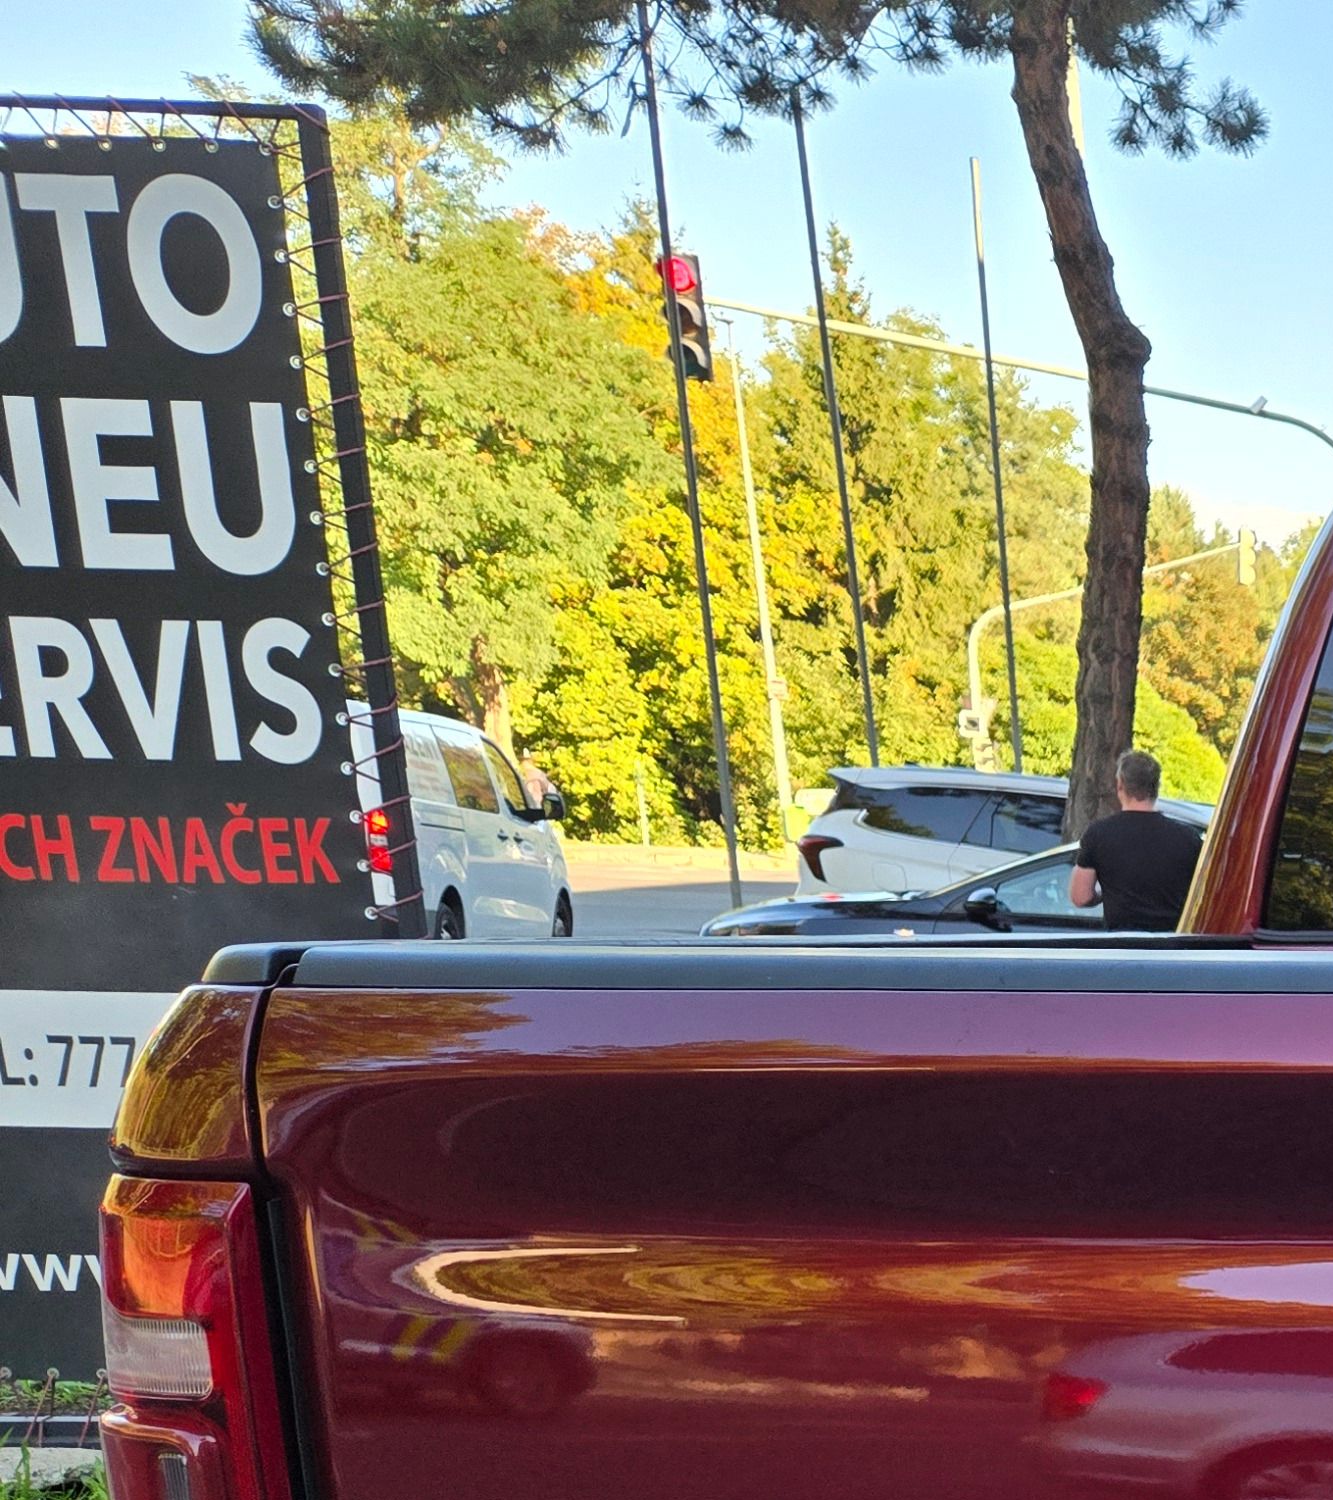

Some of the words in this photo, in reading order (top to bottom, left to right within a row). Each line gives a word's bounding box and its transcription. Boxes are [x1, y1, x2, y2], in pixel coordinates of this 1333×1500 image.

[0, 173, 262, 354] TO
[0, 616, 322, 764] RVIS
[0, 814, 80, 883] CH
[89, 803, 341, 884] ZNAČEK
